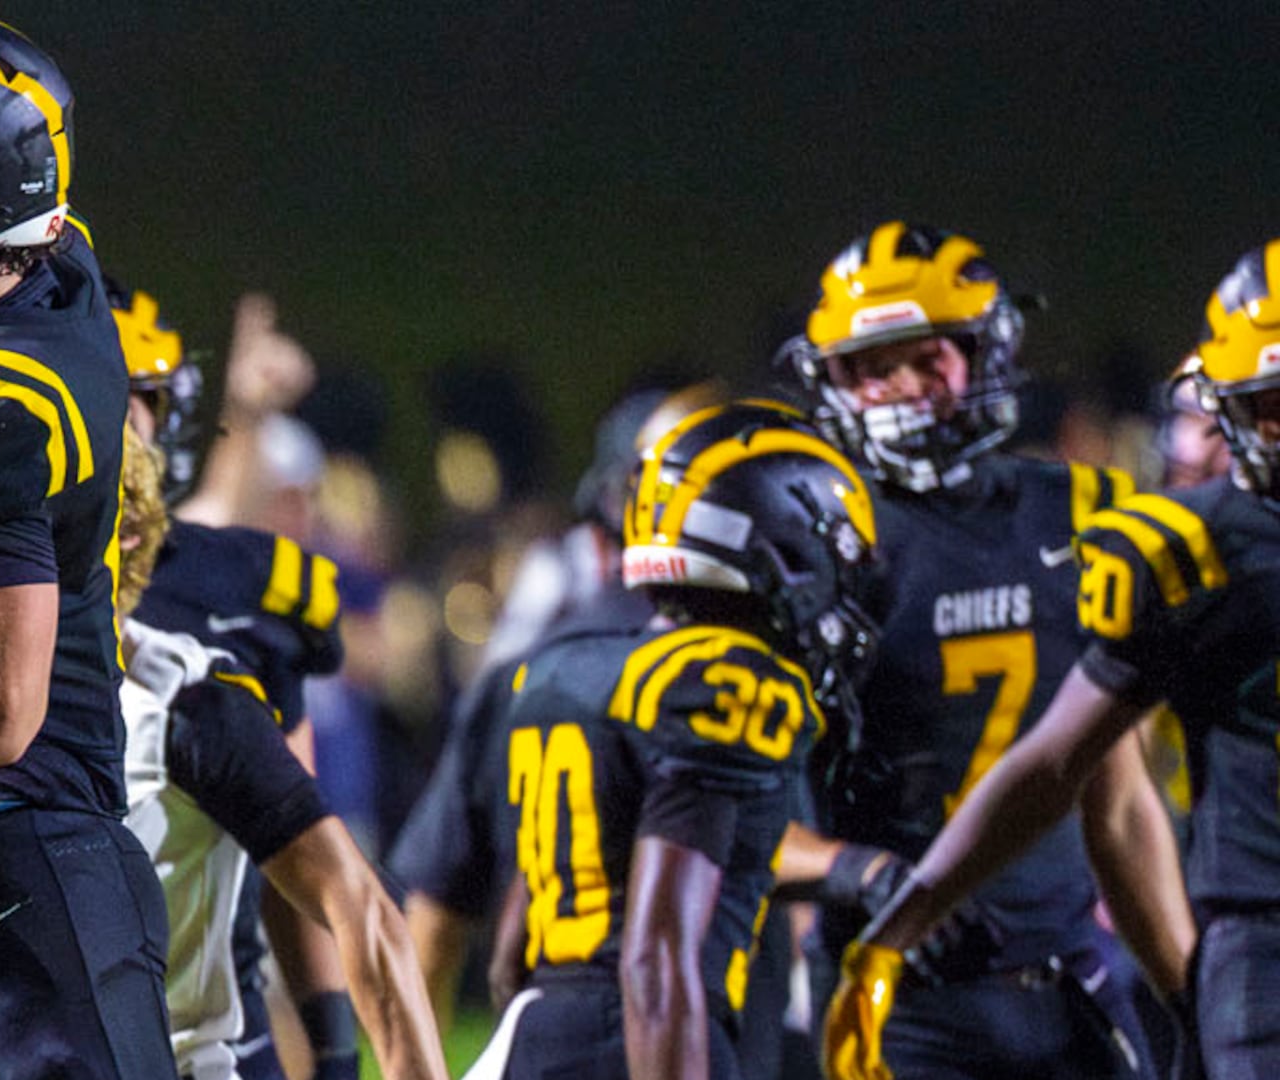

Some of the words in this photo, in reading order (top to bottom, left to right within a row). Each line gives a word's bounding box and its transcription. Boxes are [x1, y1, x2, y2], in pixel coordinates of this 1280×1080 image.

[933, 583, 1033, 637] CHIEFS
[689, 662, 805, 761] 30
[941, 630, 1037, 823] 7
